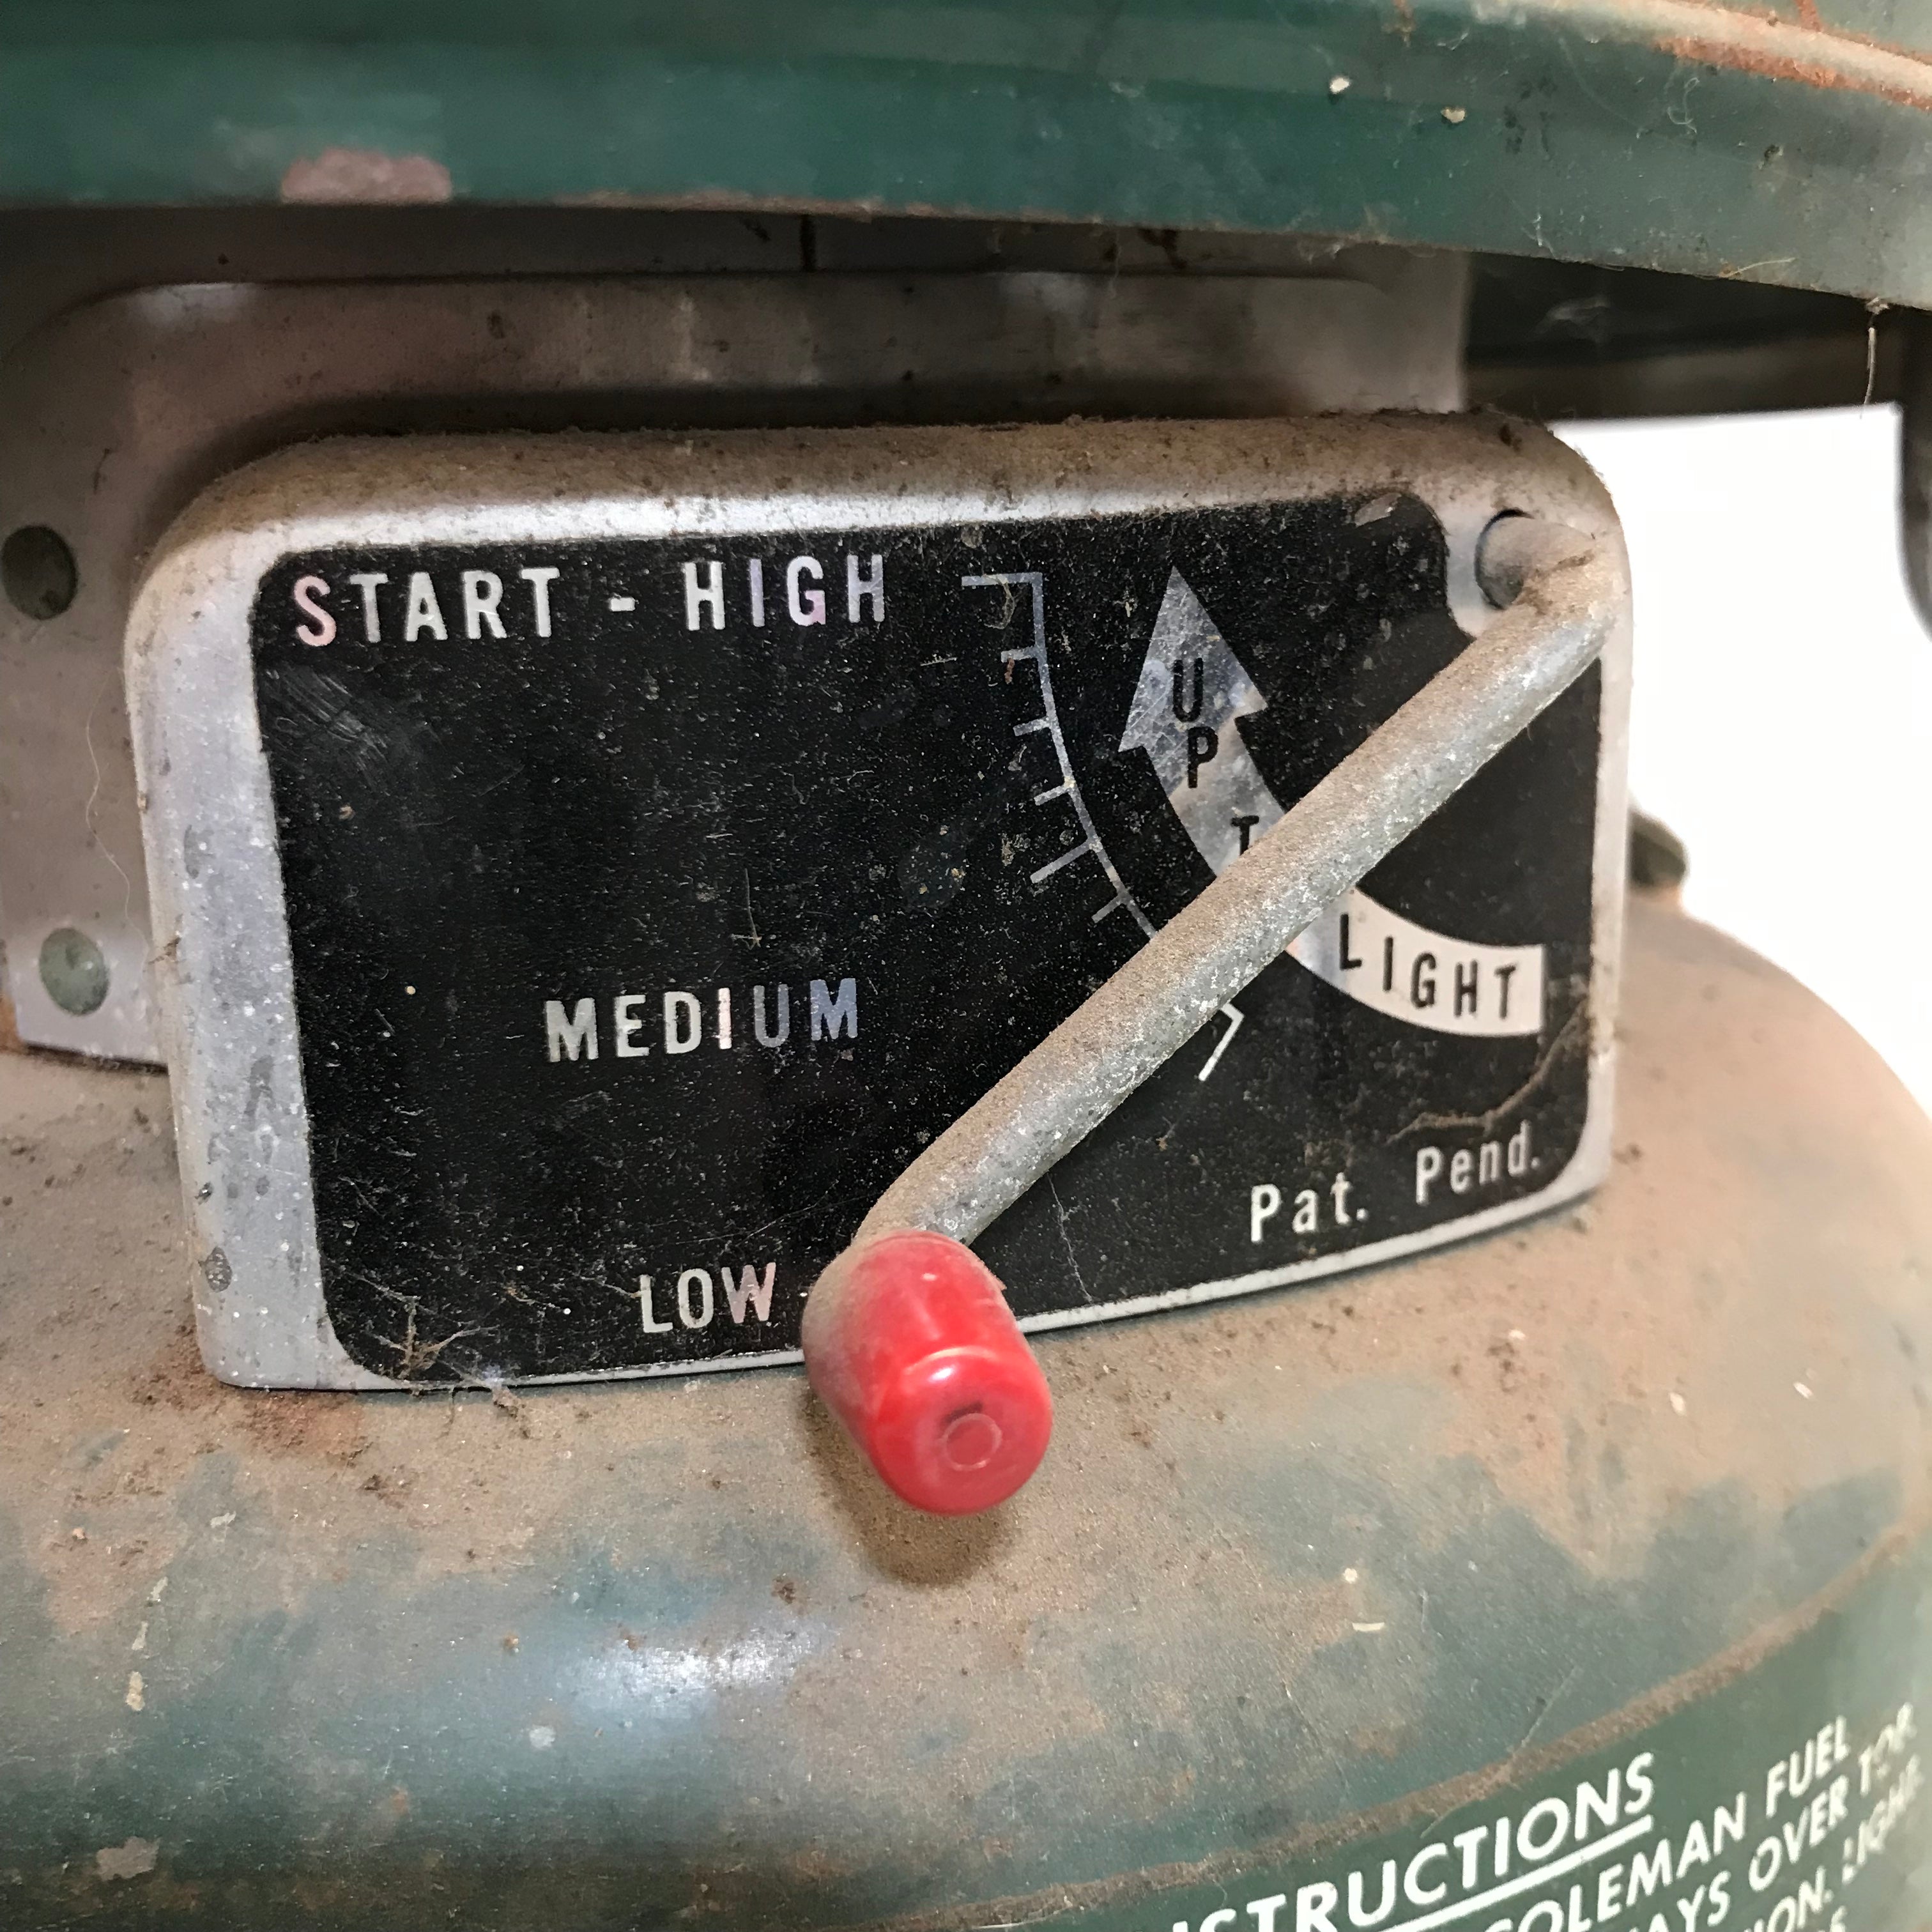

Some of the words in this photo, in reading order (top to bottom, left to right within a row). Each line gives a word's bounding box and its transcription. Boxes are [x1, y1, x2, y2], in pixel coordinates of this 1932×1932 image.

[294, 567, 560, 647] START
[608, 596, 636, 613] -
[682, 554, 884, 632] HIGH
[1172, 657, 1219, 789] UP
[1230, 815, 1260, 855] T
[1338, 914, 1517, 1020] LIGHT
[544, 977, 858, 1062] MEDIUM
[1250, 1172, 1368, 1243] Pat.
[1415, 1119, 1540, 1206] Pend.
[640, 1261, 776, 1334] LOW
[1172, 1751, 1655, 1932] TRUCTIONS
[1483, 1792, 1747, 1932] OLEMAN
[1765, 1714, 1851, 1820] FUEL
[1748, 1774, 1850, 1892] OVER
